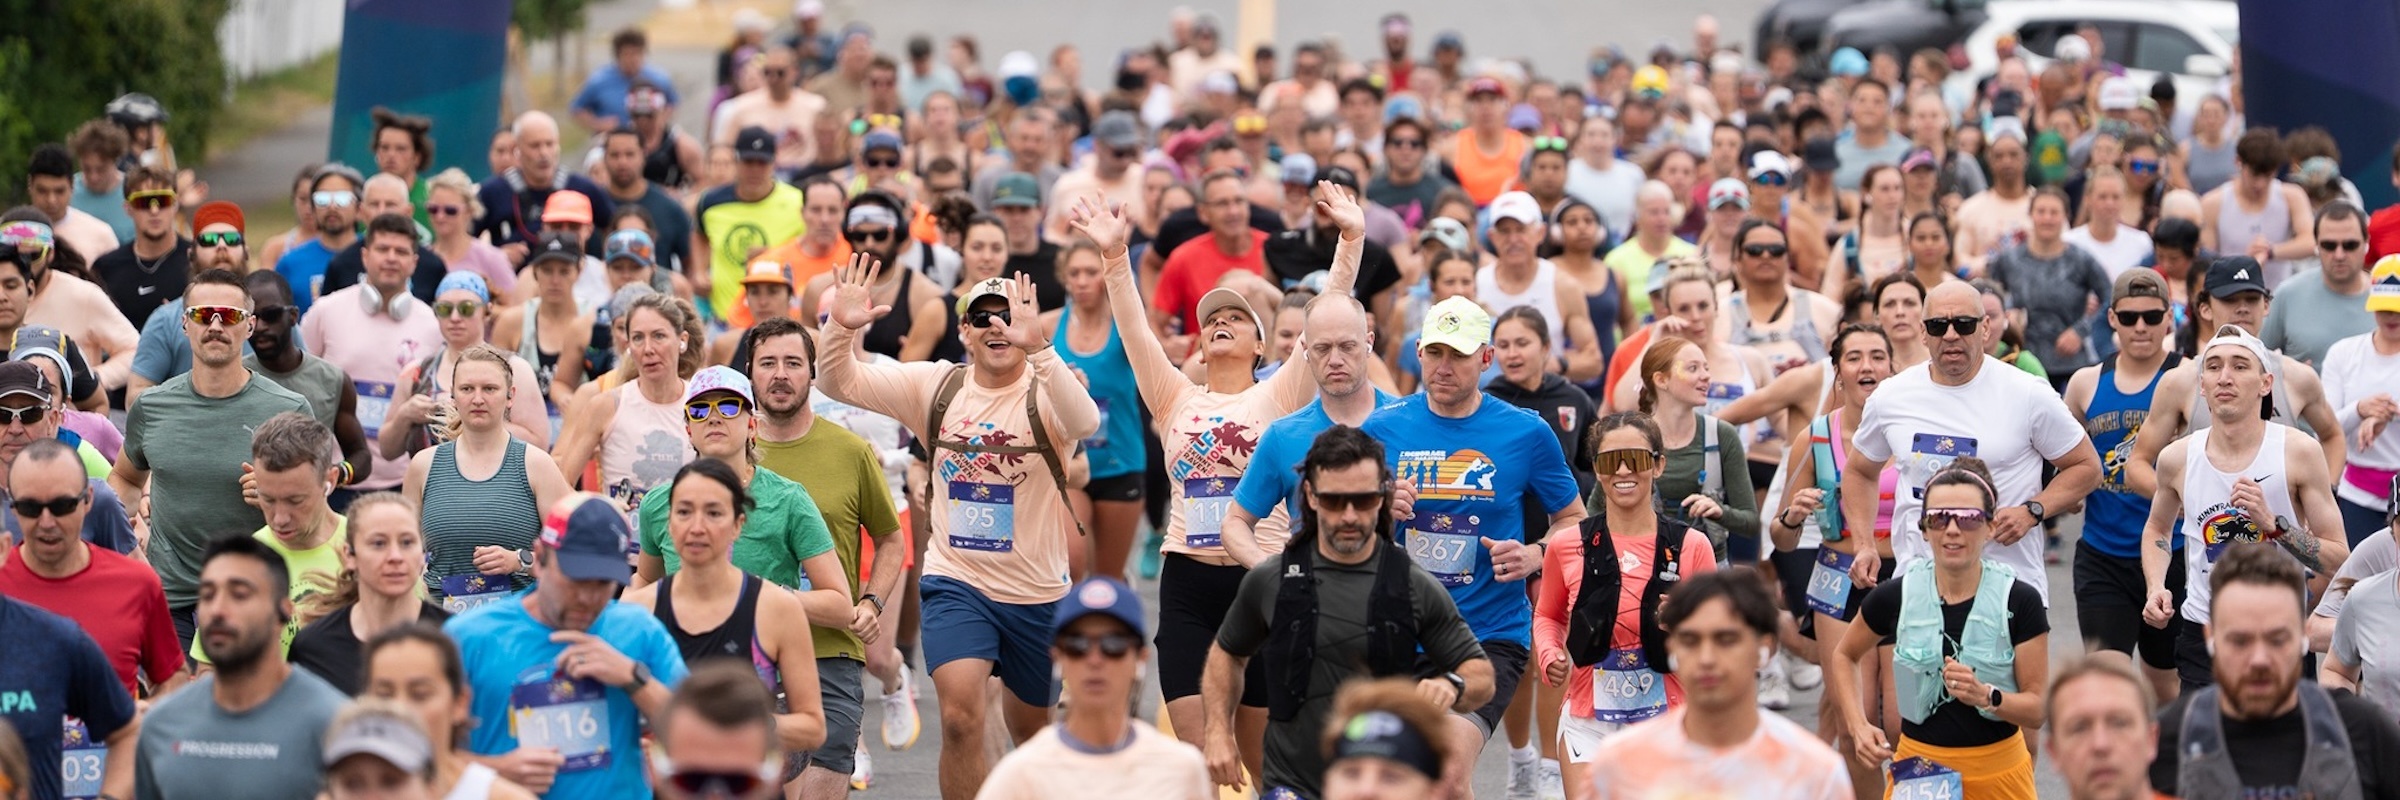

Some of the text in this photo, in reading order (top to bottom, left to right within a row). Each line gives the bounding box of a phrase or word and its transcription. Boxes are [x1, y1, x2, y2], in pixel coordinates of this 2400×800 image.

[951, 453, 974, 478] RAVEN
[1183, 452, 1208, 474] RAVEN
[965, 506, 995, 528] 95
[1193, 500, 1233, 523] 11
[1416, 536, 1467, 561] 267
[1813, 569, 1843, 595] 294
[1604, 672, 1654, 699] 469
[0, 690, 37, 714] PA
[536, 707, 598, 742] 116
[180, 740, 280, 760] PROGRESSION
[61, 755, 101, 782] 03
[1901, 779, 1952, 800] 154
